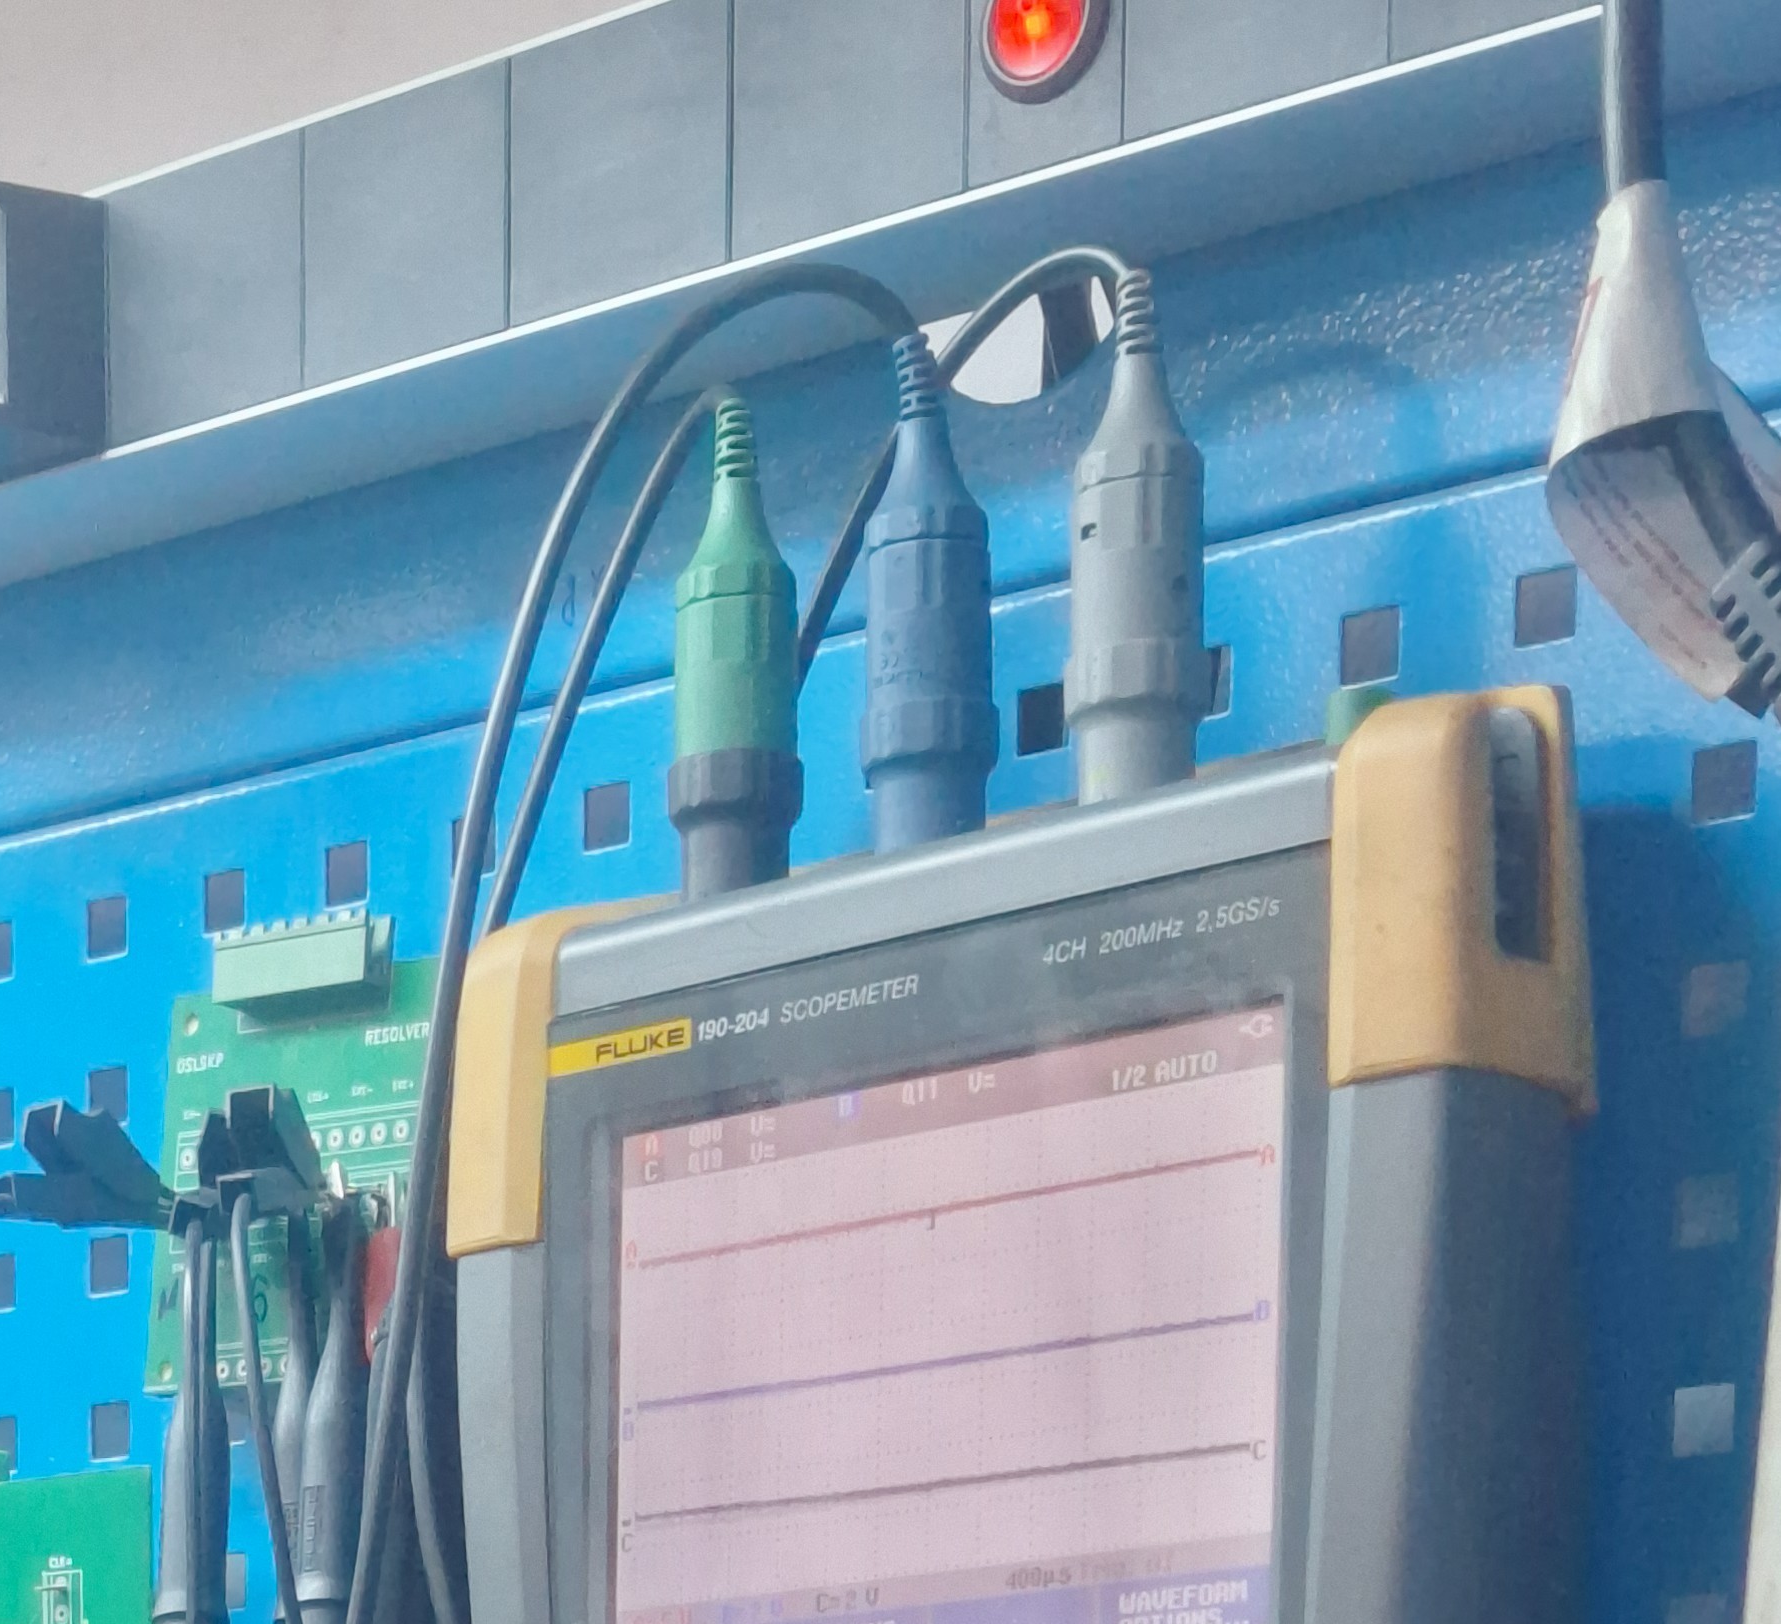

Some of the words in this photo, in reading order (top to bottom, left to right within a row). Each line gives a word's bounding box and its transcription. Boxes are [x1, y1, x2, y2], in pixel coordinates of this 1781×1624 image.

[1042, 935, 1088, 967] 4CH
[1098, 916, 1186, 956] 200MHz
[595, 1026, 686, 1064] FLUKE
[697, 1007, 771, 1042] 190-204
[780, 973, 920, 1026] SCOPEMETER
[1154, 1049, 1218, 1084] AUTO
[1118, 1579, 1249, 1616] WAVEFORM
